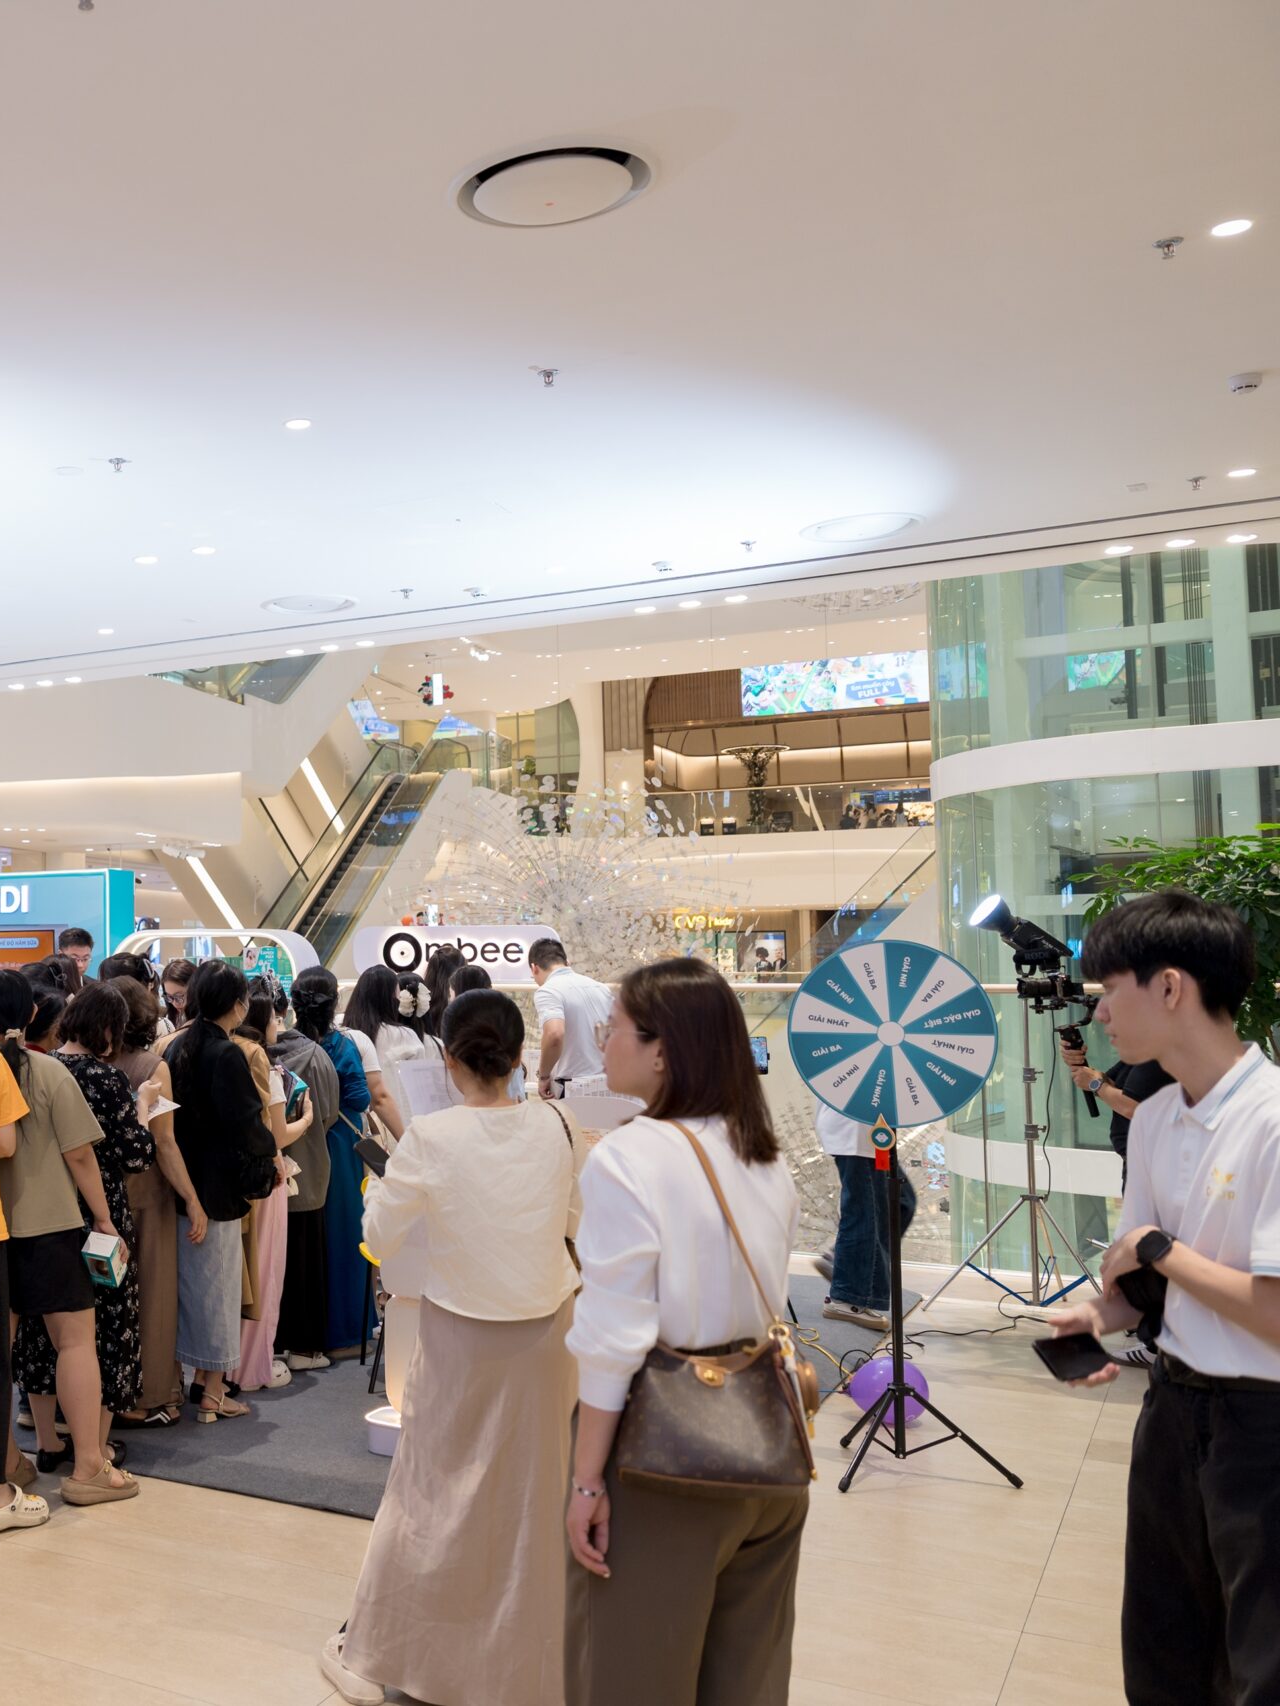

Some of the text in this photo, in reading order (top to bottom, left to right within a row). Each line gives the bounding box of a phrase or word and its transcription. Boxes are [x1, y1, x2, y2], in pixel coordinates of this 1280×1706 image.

[857, 688, 881, 698] FULL
[863, 962, 877, 991] GIẢI BA
[902, 956, 912, 973] GIẢI
[826, 979, 855, 1005] GIẢI NHÌ
[921, 979, 945, 1003] GIẢI BA
[808, 1013, 850, 1028] GIẢI NHẤT
[923, 1008, 981, 1029] GIẢI ĐẶC BIỆT
[811, 1044, 843, 1057] GIẢI BA
[931, 1039, 975, 1055] GIẢI NHẤT
[832, 1063, 860, 1088] GIẢI NHÌ
[926, 1061, 957, 1086] GIẢI NHÌ
[870, 1068, 886, 1108] GIẢI NHẤT
[905, 1077, 920, 1106] GIẢI BA
